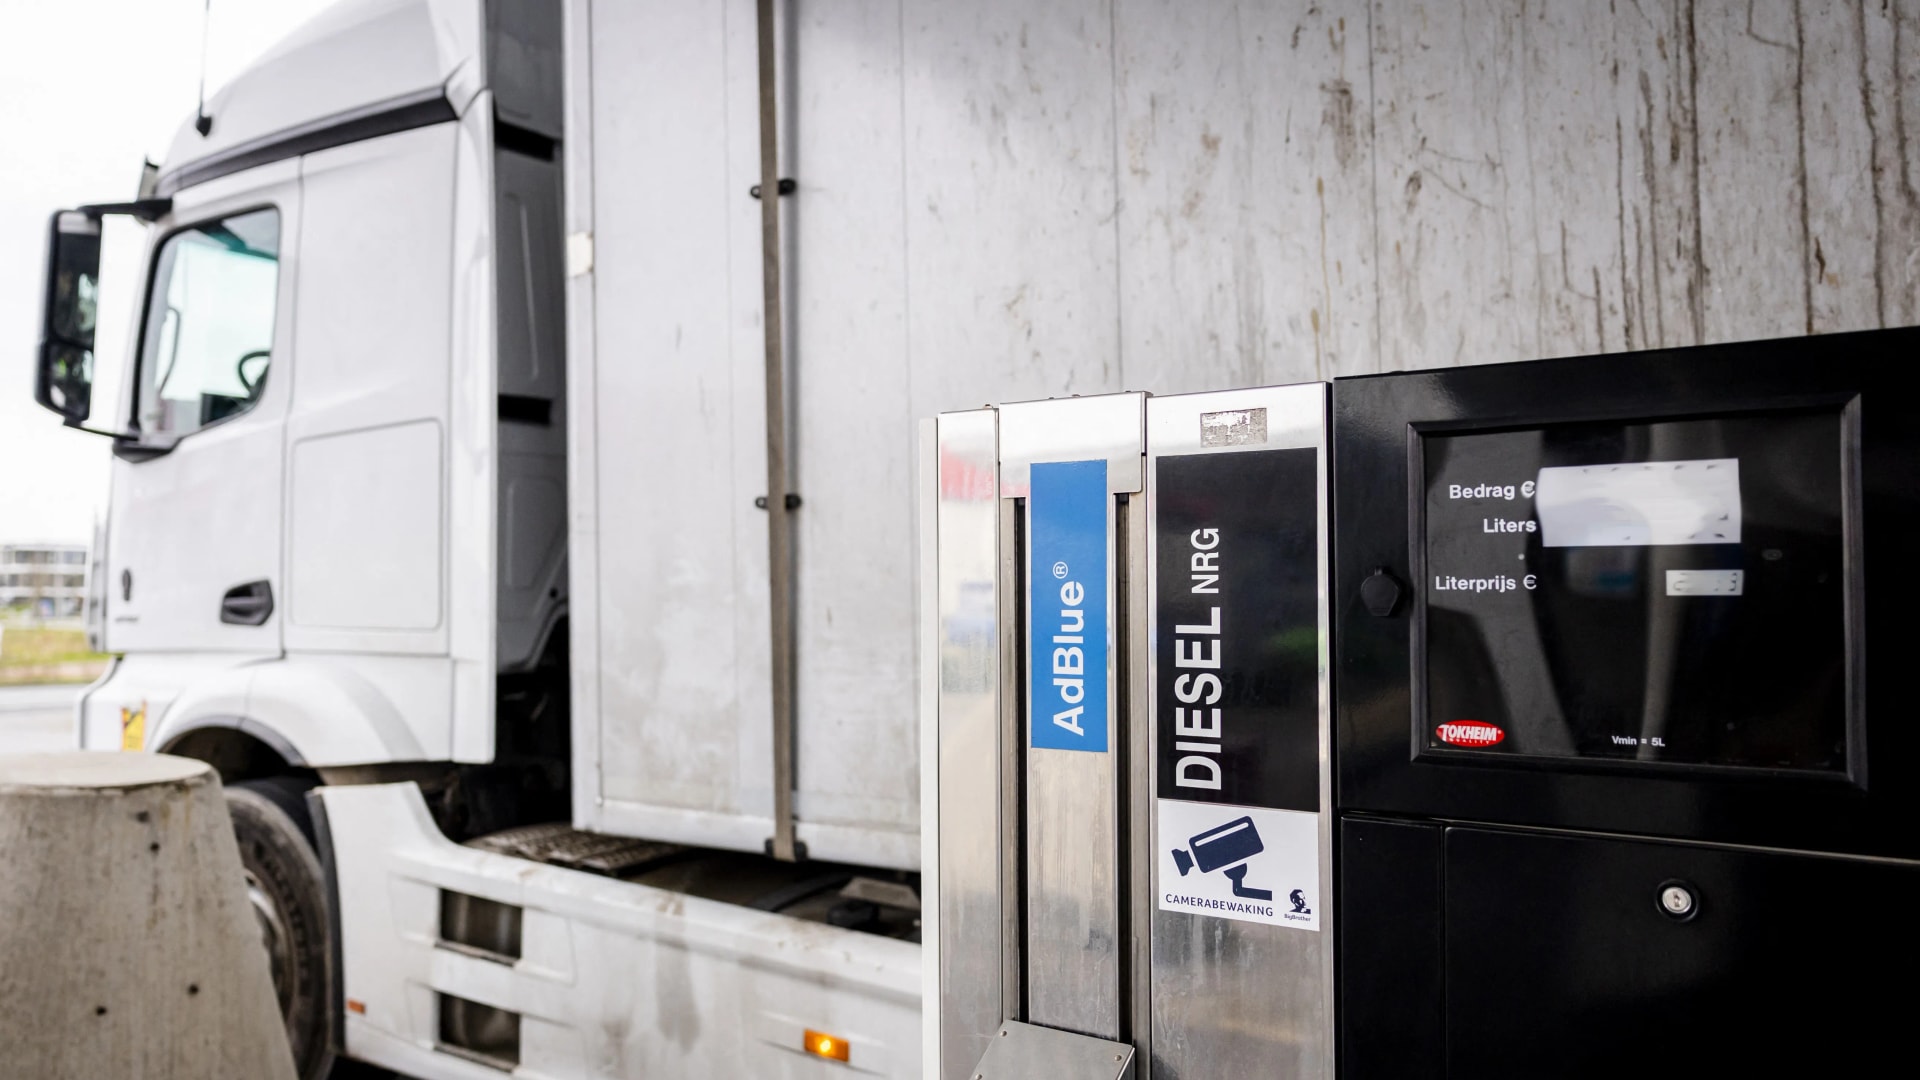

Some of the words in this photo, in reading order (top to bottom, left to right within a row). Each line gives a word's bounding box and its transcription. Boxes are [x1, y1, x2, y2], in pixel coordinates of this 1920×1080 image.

[1449, 483, 1515, 501] Bedrag
[1521, 480, 1535, 498] €
[1483, 518, 1537, 533] Liters
[1191, 528, 1219, 594] NRG
[1435, 575, 1517, 593] Literprijs
[1523, 574, 1537, 590] €
[1175, 606, 1222, 790] DIESEL
[1438, 724, 1497, 742] TOKHEIM
[1611, 735, 1637, 745] Vmin
[1651, 737, 1666, 747] 5L
[1165, 894, 1273, 917] CAMERABEWAKING
